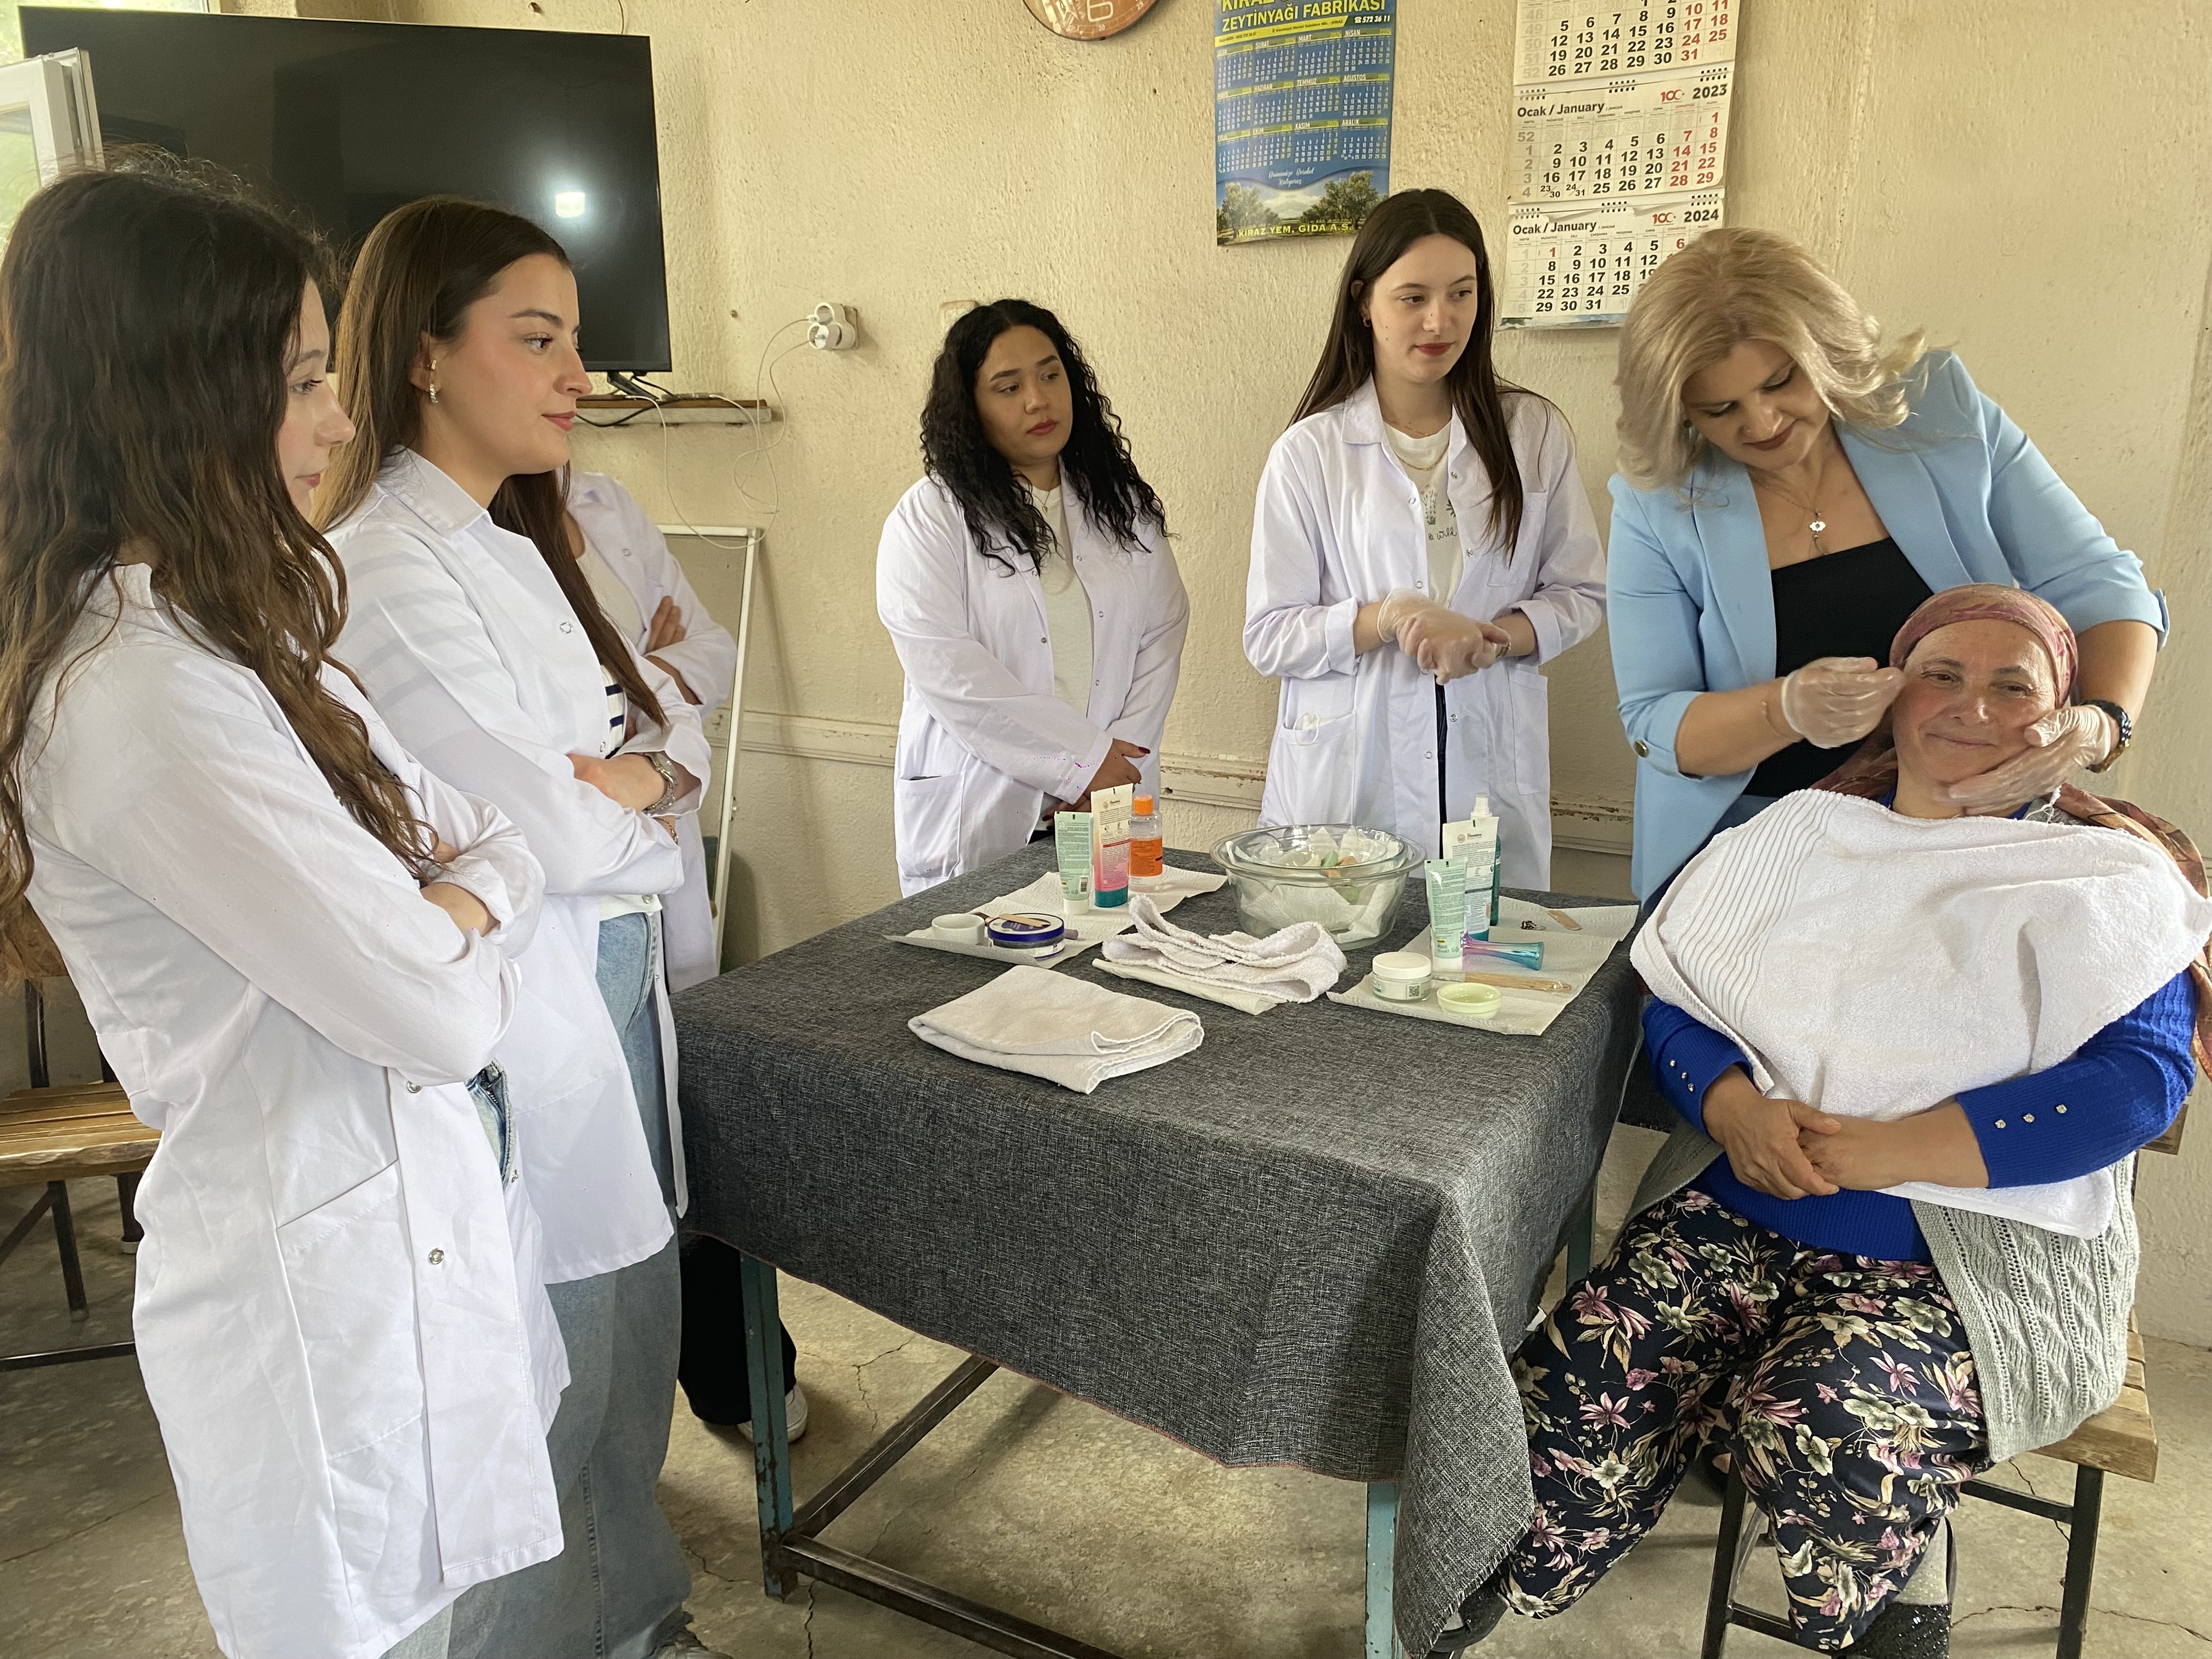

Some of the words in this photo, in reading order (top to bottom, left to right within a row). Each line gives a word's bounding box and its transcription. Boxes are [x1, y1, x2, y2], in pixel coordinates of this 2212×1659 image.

[1222, 3, 1299, 32] ZEYTİNYAĞI
[1561, 20, 1568, 31] 5
[1587, 17, 1594, 27] 6
[1613, 14, 1621, 24] 7
[1640, 11, 1647, 21] 8
[1667, 8, 1675, 18] 9
[1685, 3, 1702, 15] 10
[1713, 0, 1728, 11] 11
[1551, 35, 1567, 47] 12
[1577, 32, 1593, 44] 13
[1603, 29, 1620, 40] 14
[1630, 25, 1646, 37] 15
[1657, 22, 1674, 34] 16
[1684, 18, 1702, 31] 17
[1711, 14, 1728, 26] 18
[1550, 50, 1566, 61] 19
[1575, 47, 1592, 59] 20
[1601, 43, 1617, 55] 21
[1628, 41, 1645, 53] 22
[1655, 37, 1673, 49] 23
[1682, 33, 1700, 46] 24
[1709, 29, 1726, 42] 25
[1549, 65, 1566, 76] 26
[1575, 61, 1592, 74] 27
[1600, 59, 1617, 71] 28
[1627, 55, 1644, 67] 29
[1654, 52, 1672, 64] 30
[1681, 48, 1697, 61] 31
[1692, 84, 1727, 99] 2023
[1517, 106, 1545, 117] Ocak
[1549, 105, 1555, 115] /
[1557, 103, 1604, 114] January
[1517, 132, 1534, 142] 52
[1712, 112, 1718, 123] 1
[1526, 145, 1532, 155] 1
[1554, 144, 1561, 154] 2
[1579, 142, 1587, 152] 3
[1605, 139, 1613, 150] 4
[1630, 136, 1639, 146] 5
[1657, 133, 1664, 144] 6
[1684, 131, 1692, 142] 7
[1710, 127, 1718, 138] 8
[1525, 160, 1533, 169] 2
[1553, 158, 1561, 168] 9
[1570, 156, 1586, 167] 10
[1596, 154, 1611, 165] 11
[1621, 151, 1638, 162] 12
[1647, 148, 1663, 160] 13
[1673, 145, 1690, 157] 14
[1700, 142, 1716, 154] 15
[1523, 173, 1531, 183] 3
[1544, 172, 1560, 183] 16
[1569, 170, 1585, 181] 17
[1595, 168, 1611, 179] 18
[1620, 165, 1637, 176] 19
[1645, 163, 1662, 174] 20
[1671, 160, 1688, 172] 21
[1698, 157, 1715, 170] 22
[1522, 187, 1531, 198] 4
[1593, 183, 1610, 194] 25
[1618, 180, 1635, 191] 26
[1644, 177, 1661, 189] 27
[1670, 175, 1688, 187] 28
[1697, 172, 1713, 184] 29
[1684, 209, 1718, 222] 2024
[1239, 228, 1266, 238] KİRAZ
[1299, 224, 1326, 233] GIDA
[1513, 224, 1540, 234] Ocak
[1543, 223, 1548, 233] /
[1551, 222, 1596, 232] January
[1550, 247, 1555, 257] 1
[1573, 246, 1581, 256] 2
[1599, 244, 1606, 254] 3
[1624, 242, 1632, 252] 4
[1650, 240, 1658, 251] 5
[1677, 239, 1686, 250] 6
[1548, 261, 1555, 271] 8
[1573, 259, 1581, 269] 9
[1590, 258, 1606, 268] 10
[1615, 256, 1630, 267] 11
[1641, 255, 1657, 265] 12
[1539, 275, 1555, 285] 15
[1564, 274, 1579, 284] 16
[1589, 272, 1605, 282] 17
[1615, 270, 1630, 281] 18
[1537, 289, 1554, 298] 22
[1562, 287, 1578, 297] 23
[1587, 286, 1604, 296] 24
[1612, 285, 1629, 295] 25
[1536, 302, 1552, 312] 29
[1561, 301, 1577, 311] 30
[1585, 300, 1601, 309] 31
